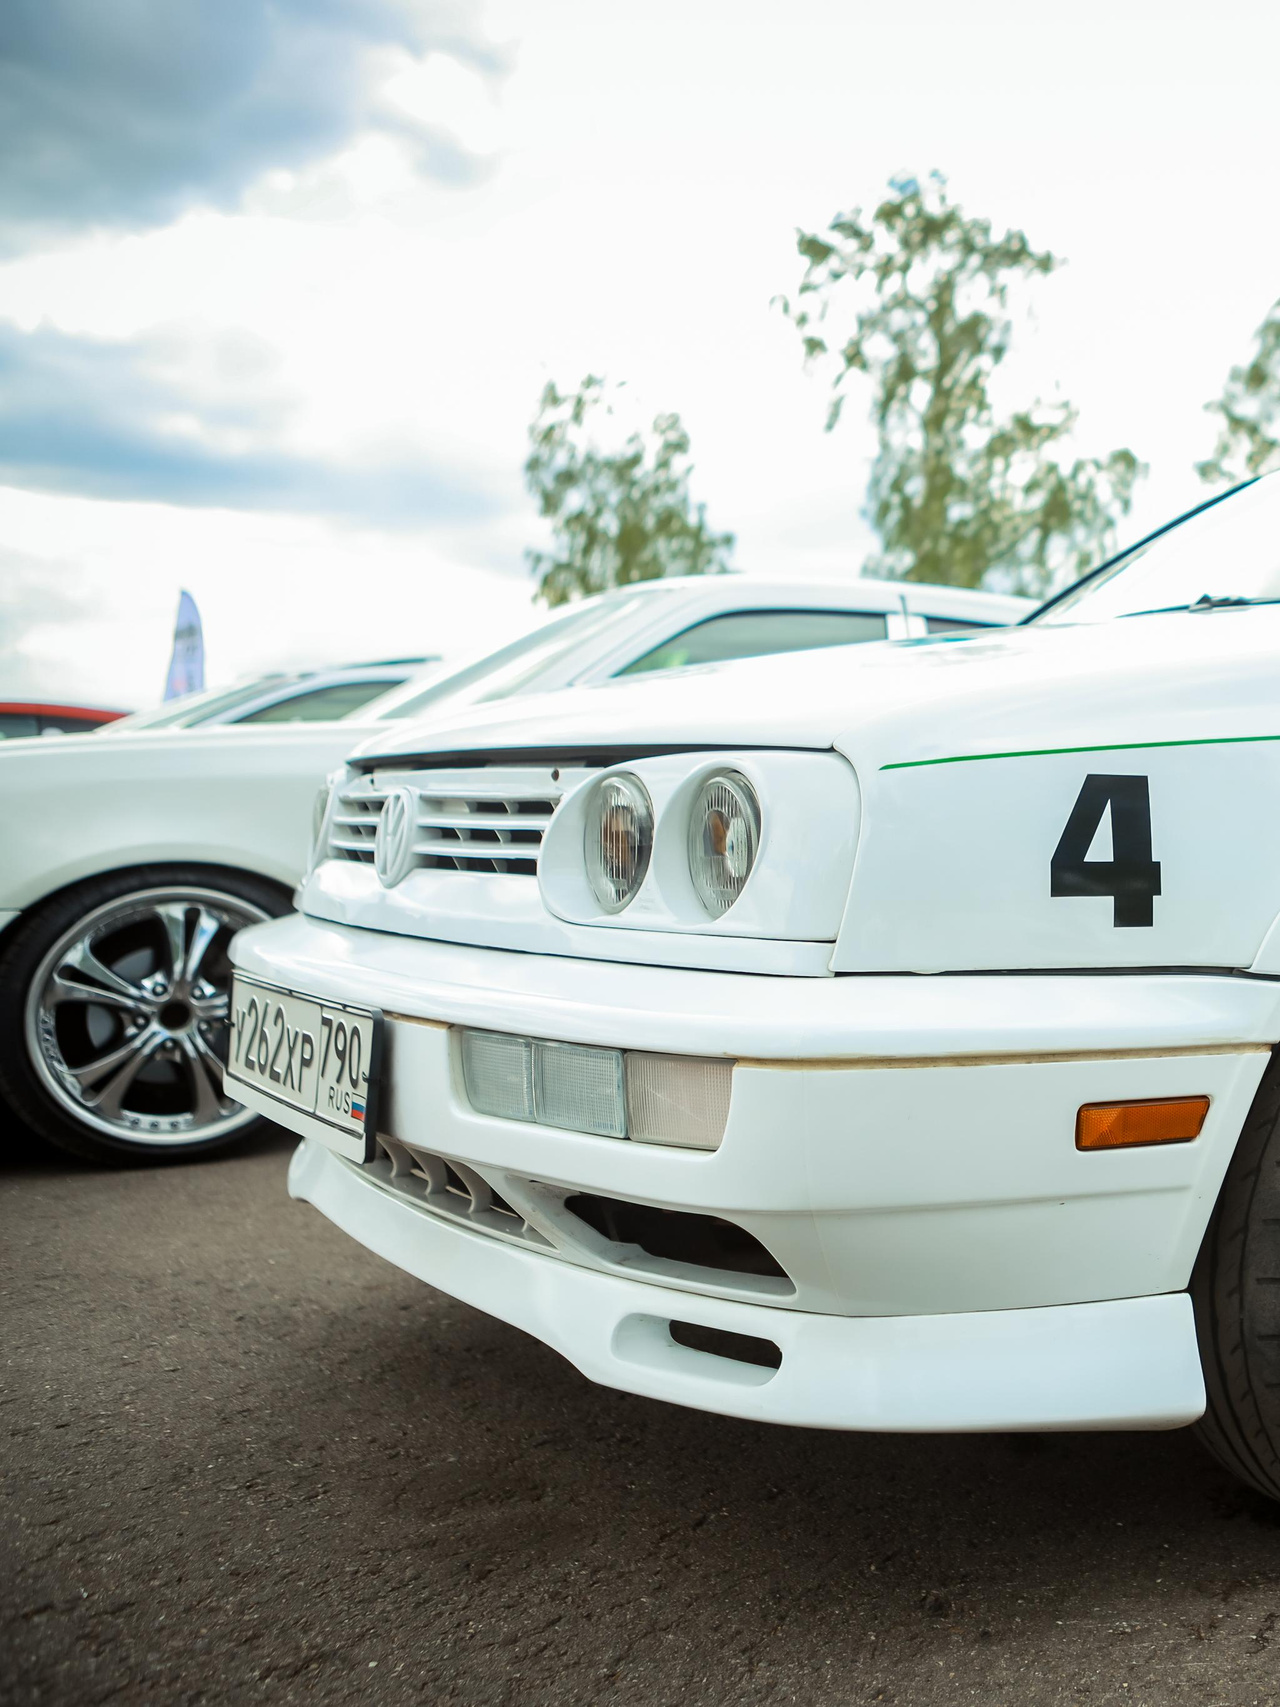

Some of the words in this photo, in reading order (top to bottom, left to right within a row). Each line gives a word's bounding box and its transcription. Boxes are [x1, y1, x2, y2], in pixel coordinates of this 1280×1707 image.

[1050, 774, 1162, 927] 4
[321, 1013, 362, 1089] 790
[328, 1086, 350, 1114] RUS
